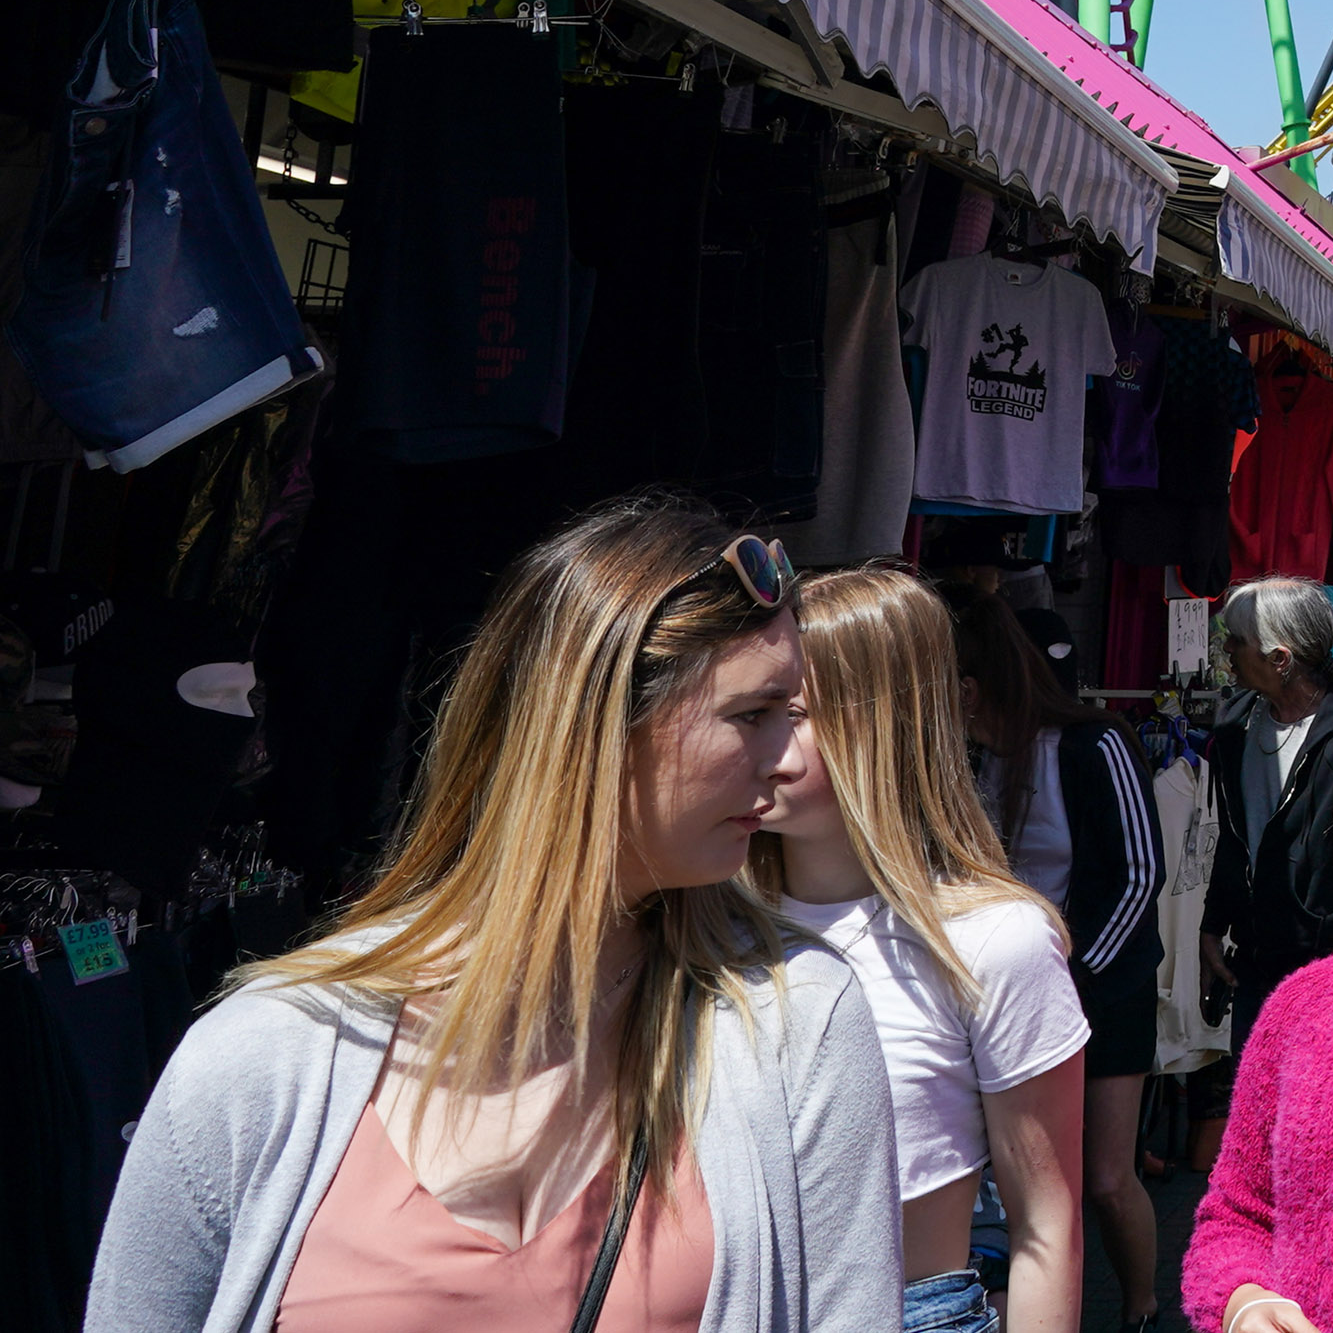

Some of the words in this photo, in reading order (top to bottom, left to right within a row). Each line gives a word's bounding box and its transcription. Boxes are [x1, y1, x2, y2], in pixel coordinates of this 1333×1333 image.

[981, 323, 1004, 344] #1
[968, 376, 1045, 410] FORTNITE
[971, 400, 1034, 420] LEGEND
